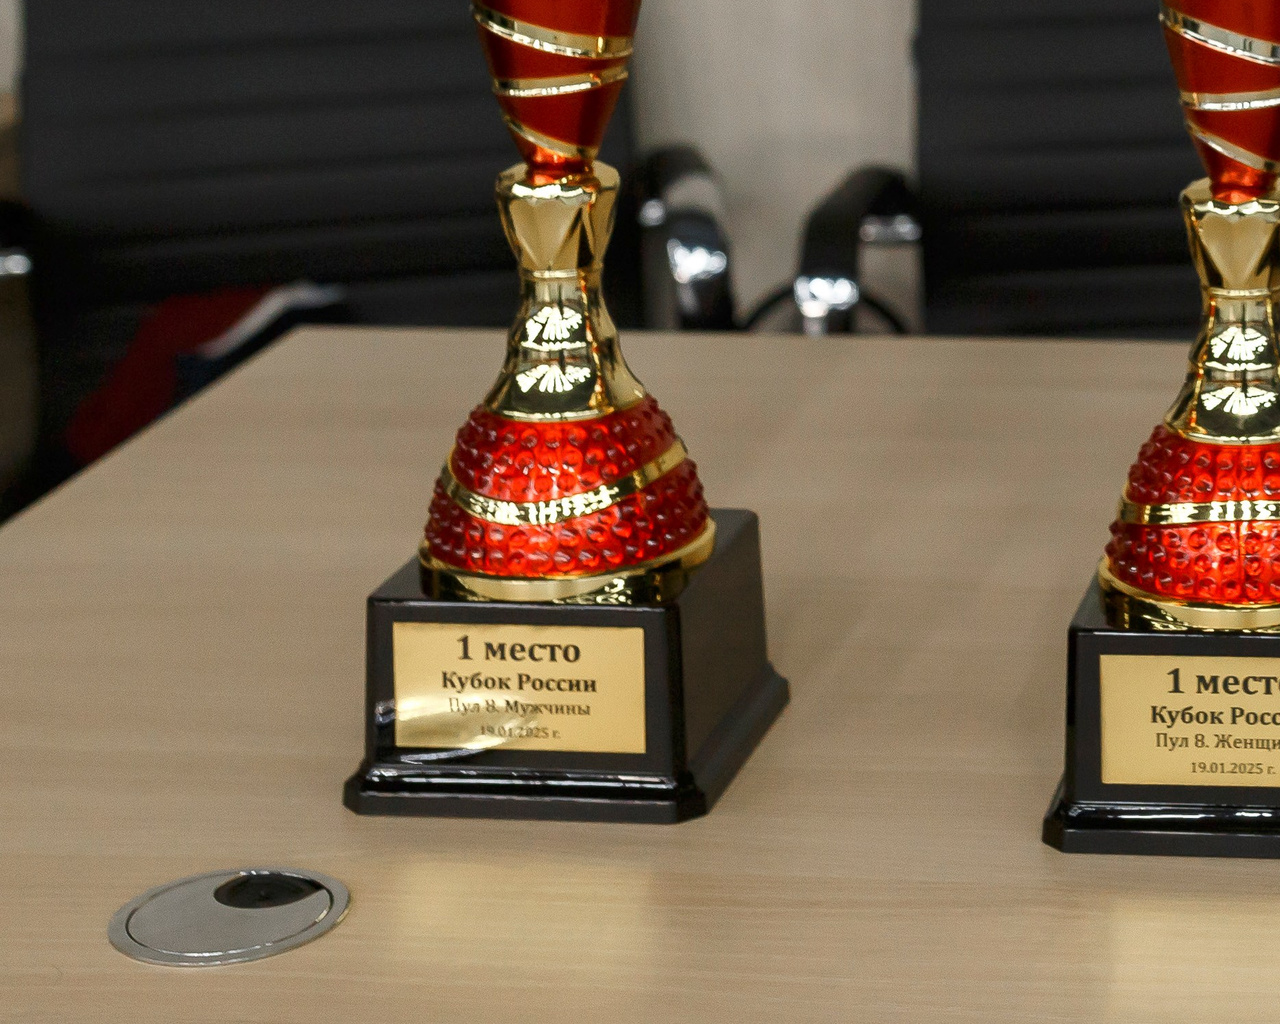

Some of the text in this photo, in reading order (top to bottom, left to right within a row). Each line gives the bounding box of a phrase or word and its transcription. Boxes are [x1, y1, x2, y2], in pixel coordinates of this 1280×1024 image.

[456, 634, 581, 664] 1 место
[441, 670, 597, 694] Кубок России
[1166, 667, 1185, 694] 1
[449, 697, 480, 716] Пул
[505, 699, 591, 717] Мужчины
[1150, 705, 1224, 728] Кубок
[552, 729, 562, 739] г.
[1155, 733, 1189, 751] Пул
[1194, 733, 1210, 749] 8.
[1190, 762, 1277, 775] 19.01.2025 г.
